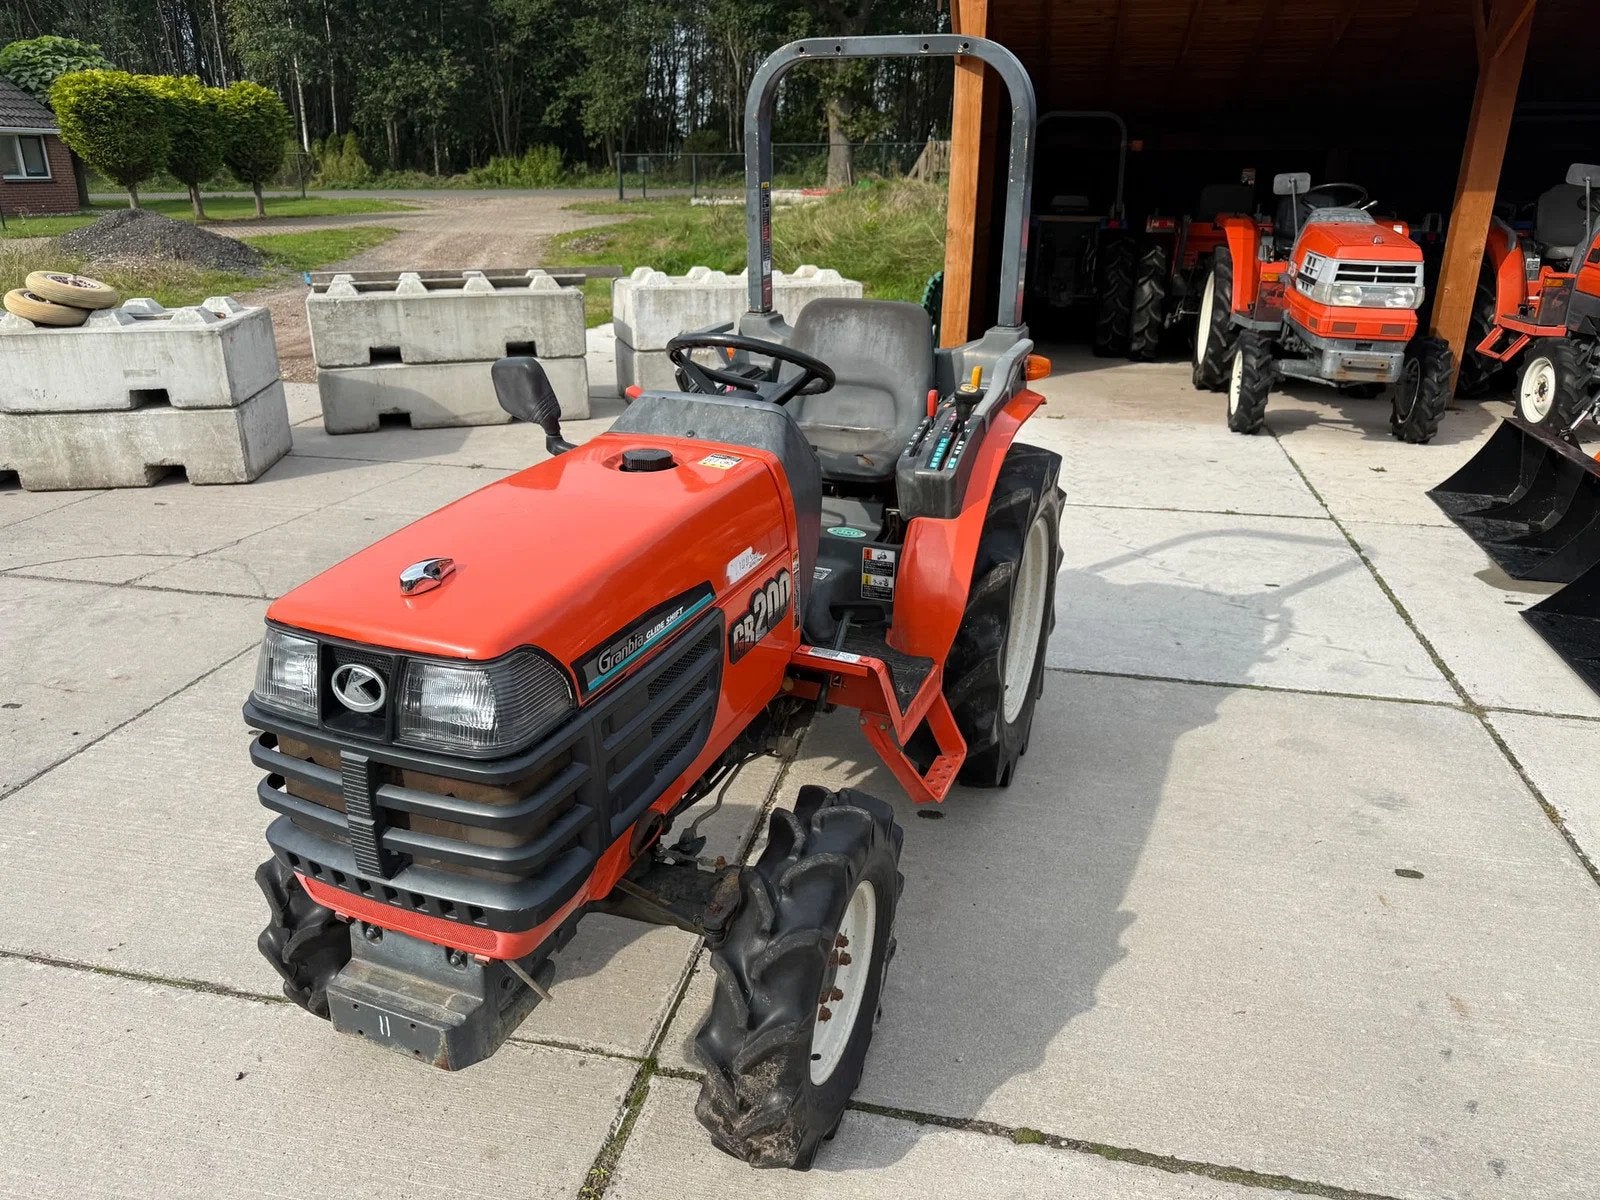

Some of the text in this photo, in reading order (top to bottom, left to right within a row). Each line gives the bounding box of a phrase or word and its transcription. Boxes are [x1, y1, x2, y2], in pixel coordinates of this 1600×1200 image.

[598, 606, 684, 674] Granbia GLIDE SHIFT
